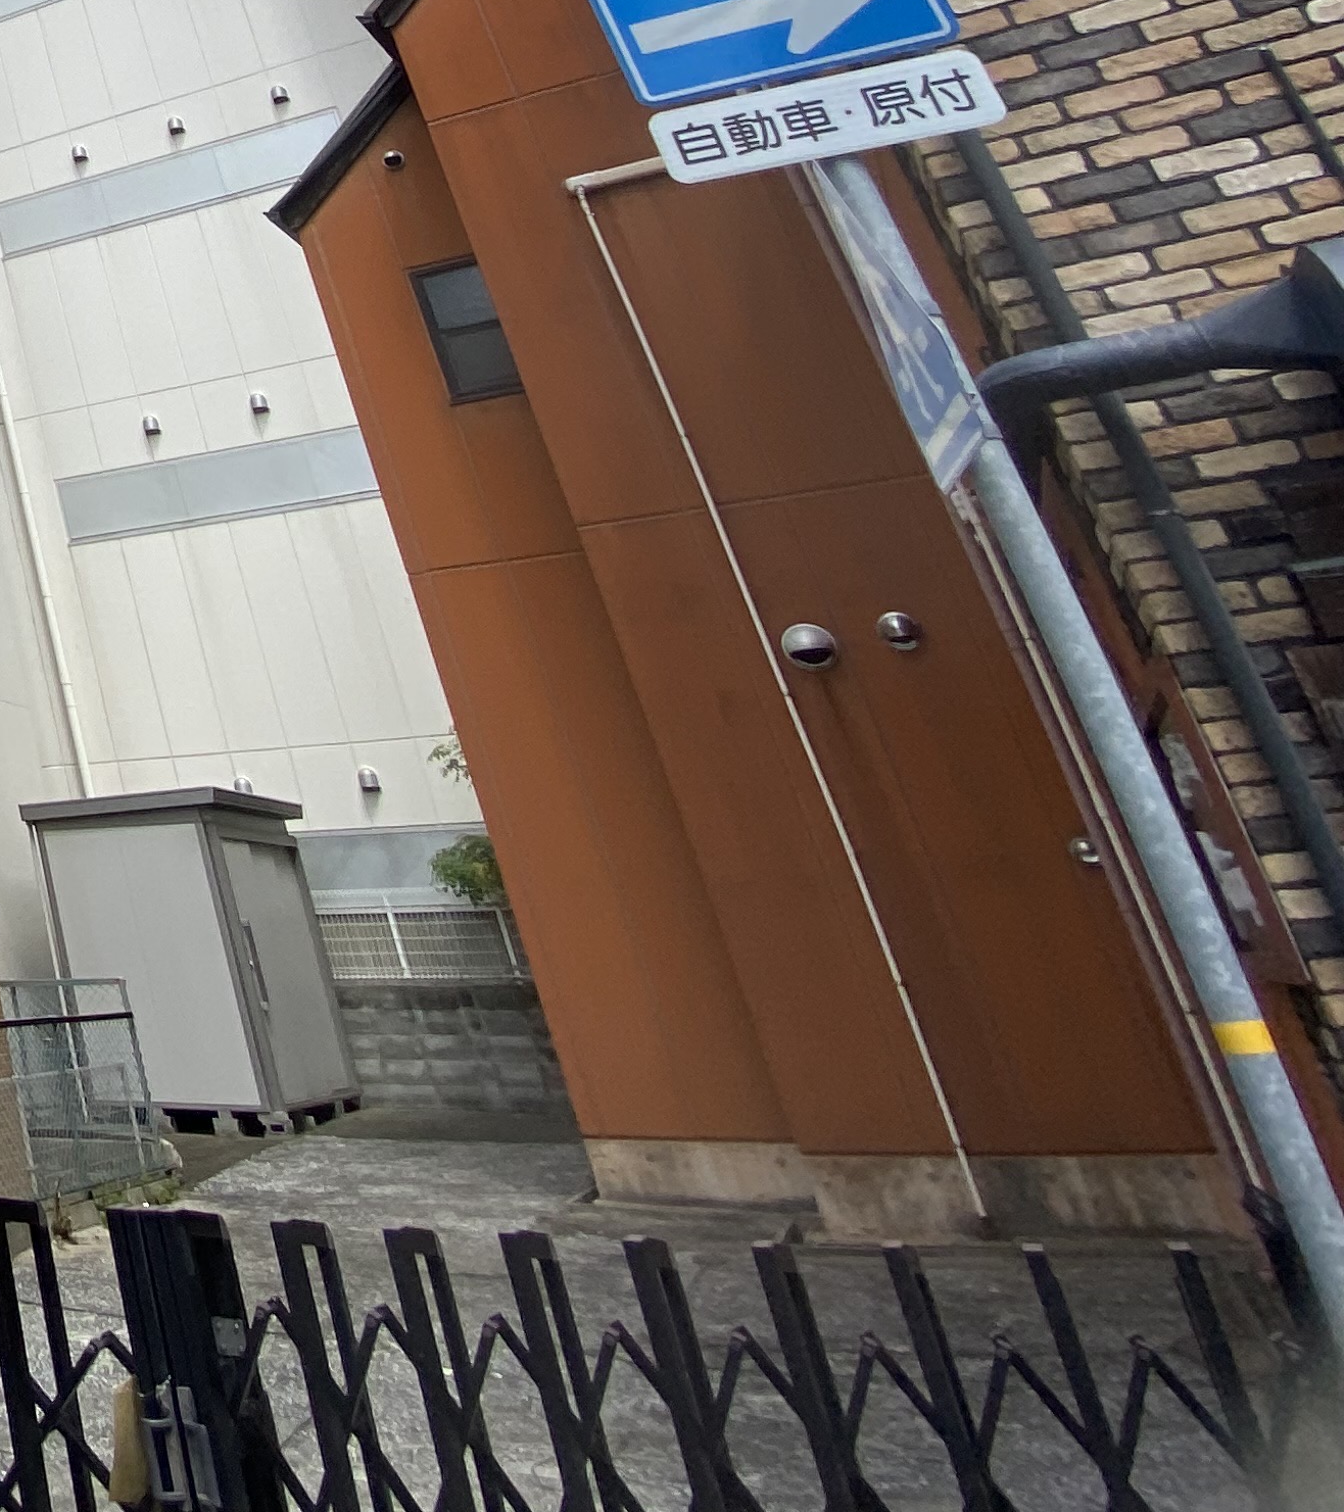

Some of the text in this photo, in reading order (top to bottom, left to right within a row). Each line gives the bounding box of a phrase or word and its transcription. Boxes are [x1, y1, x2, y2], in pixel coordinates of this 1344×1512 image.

[672, 68, 977, 166] 自動車・原付
